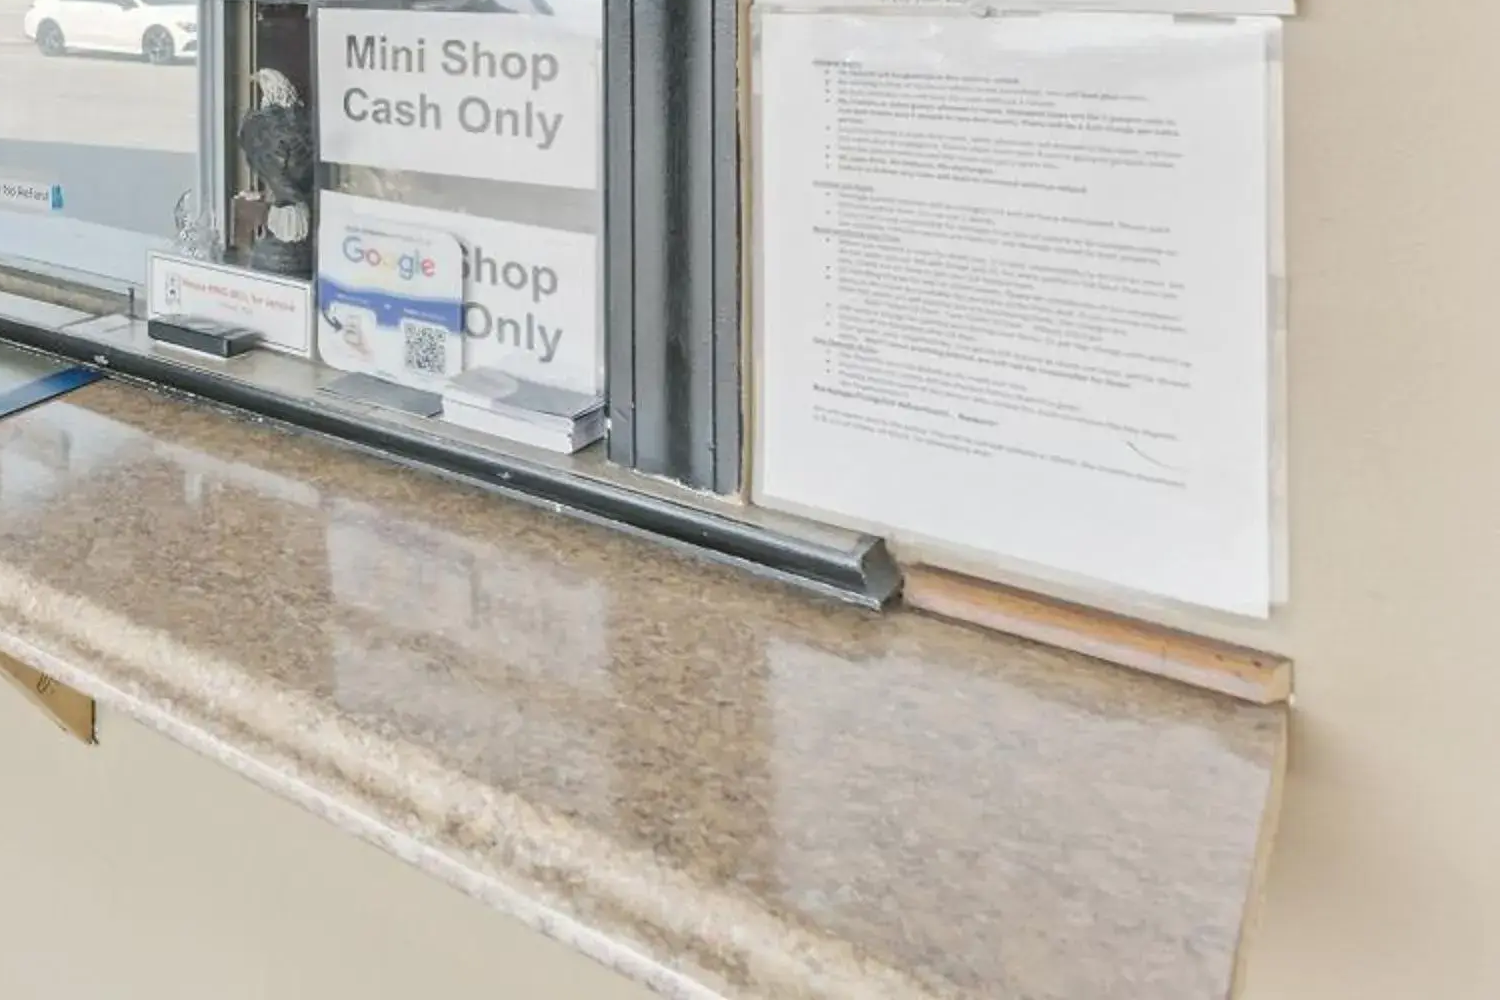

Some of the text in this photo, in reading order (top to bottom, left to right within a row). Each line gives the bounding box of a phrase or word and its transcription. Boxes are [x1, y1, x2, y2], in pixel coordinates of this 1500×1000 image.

[346, 34, 561, 84] Mini Shop
[342, 86, 565, 150] Cash Only
[342, 235, 437, 281] Google
[463, 302, 565, 364] Only
